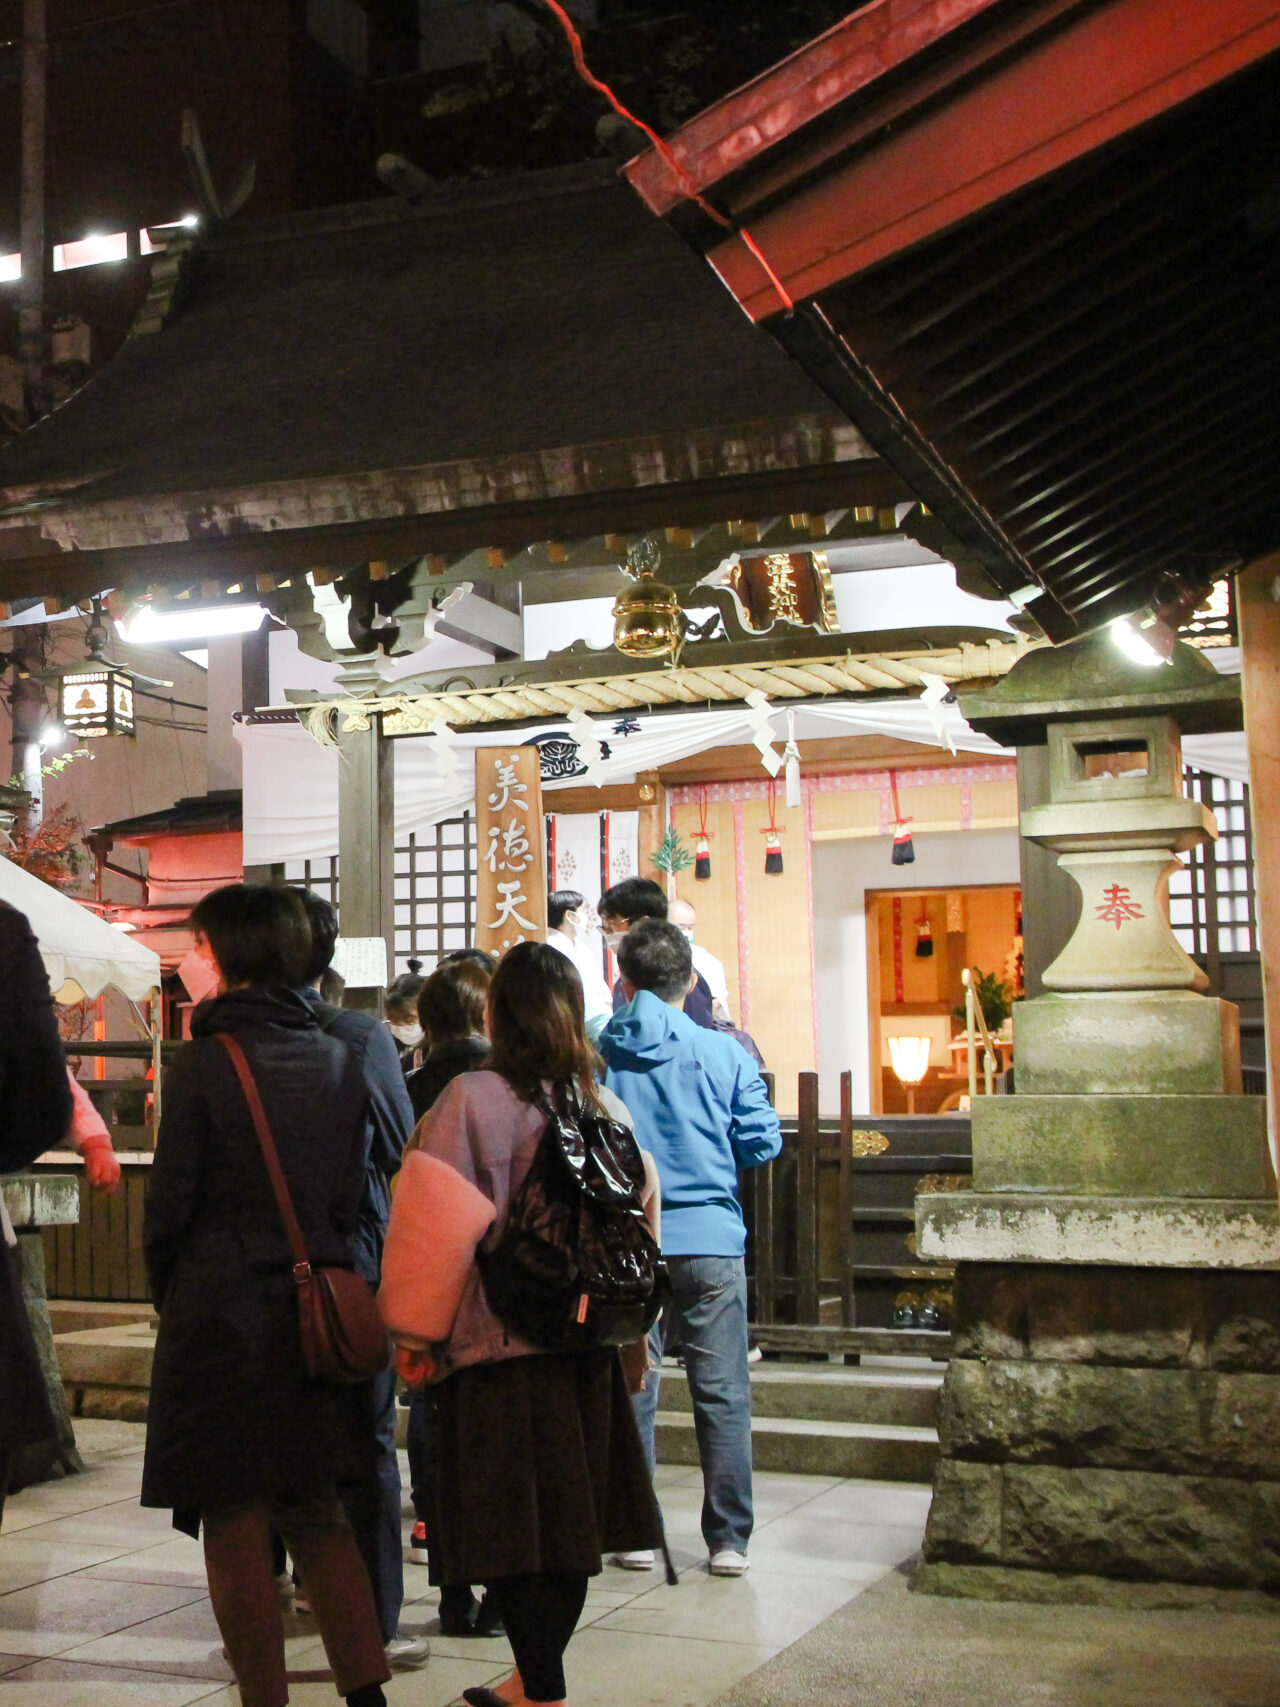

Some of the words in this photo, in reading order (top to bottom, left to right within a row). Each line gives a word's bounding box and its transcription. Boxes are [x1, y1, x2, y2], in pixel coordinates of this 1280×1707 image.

[483, 754, 539, 958] 美徳天
[1094, 883, 1146, 931] 奉
